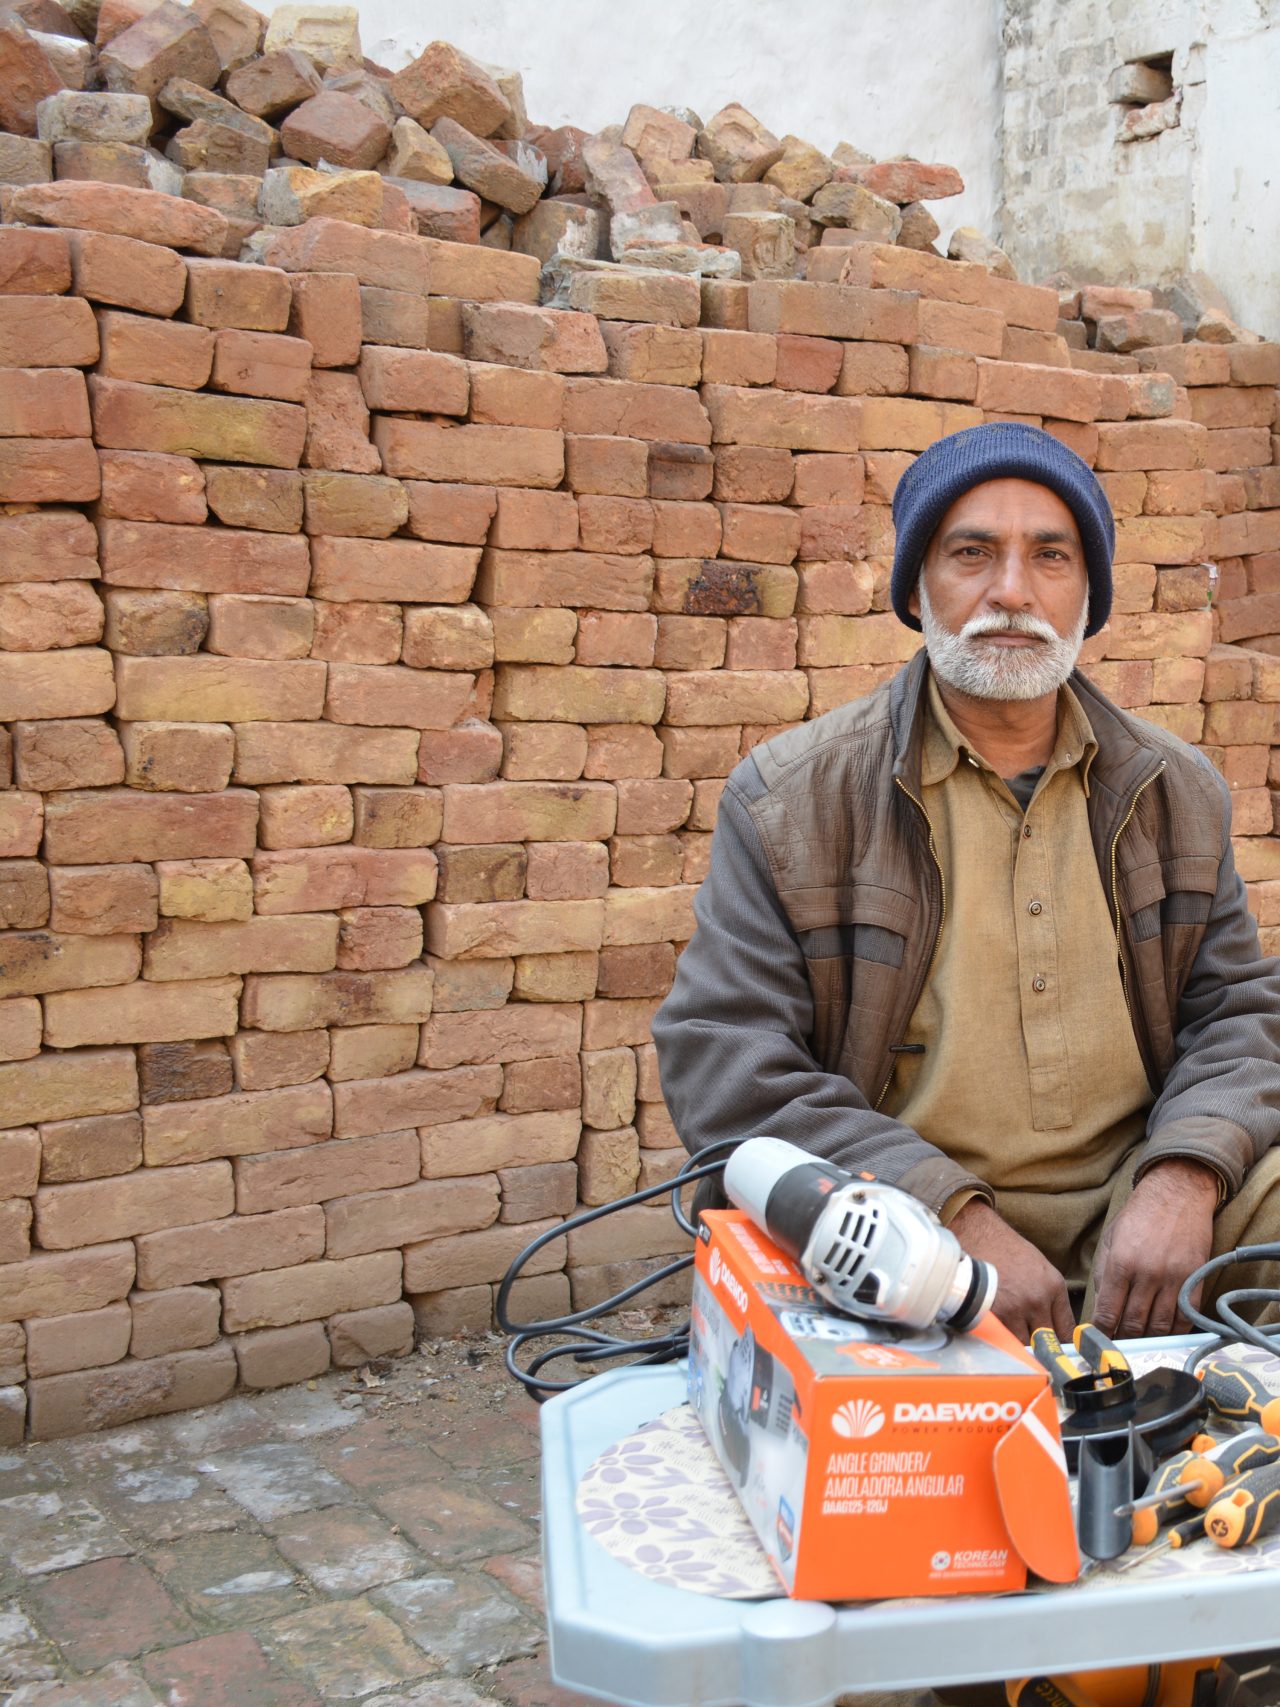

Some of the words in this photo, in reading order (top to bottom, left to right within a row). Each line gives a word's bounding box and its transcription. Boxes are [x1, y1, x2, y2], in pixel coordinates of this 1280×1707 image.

[720, 1262, 748, 1313] DAEWOO
[893, 1401, 1022, 1423] DAEWOO
[892, 1426, 939, 1434] POWER
[826, 1452, 870, 1474] ANGLE
[869, 1451, 931, 1473] GRINDER/
[824, 1476, 905, 1498] AMOLADORA
[905, 1474, 965, 1496] ANGULAR
[953, 1559, 1008, 1569] TECHNOLOGY
[954, 1549, 1008, 1561] KOREAN
